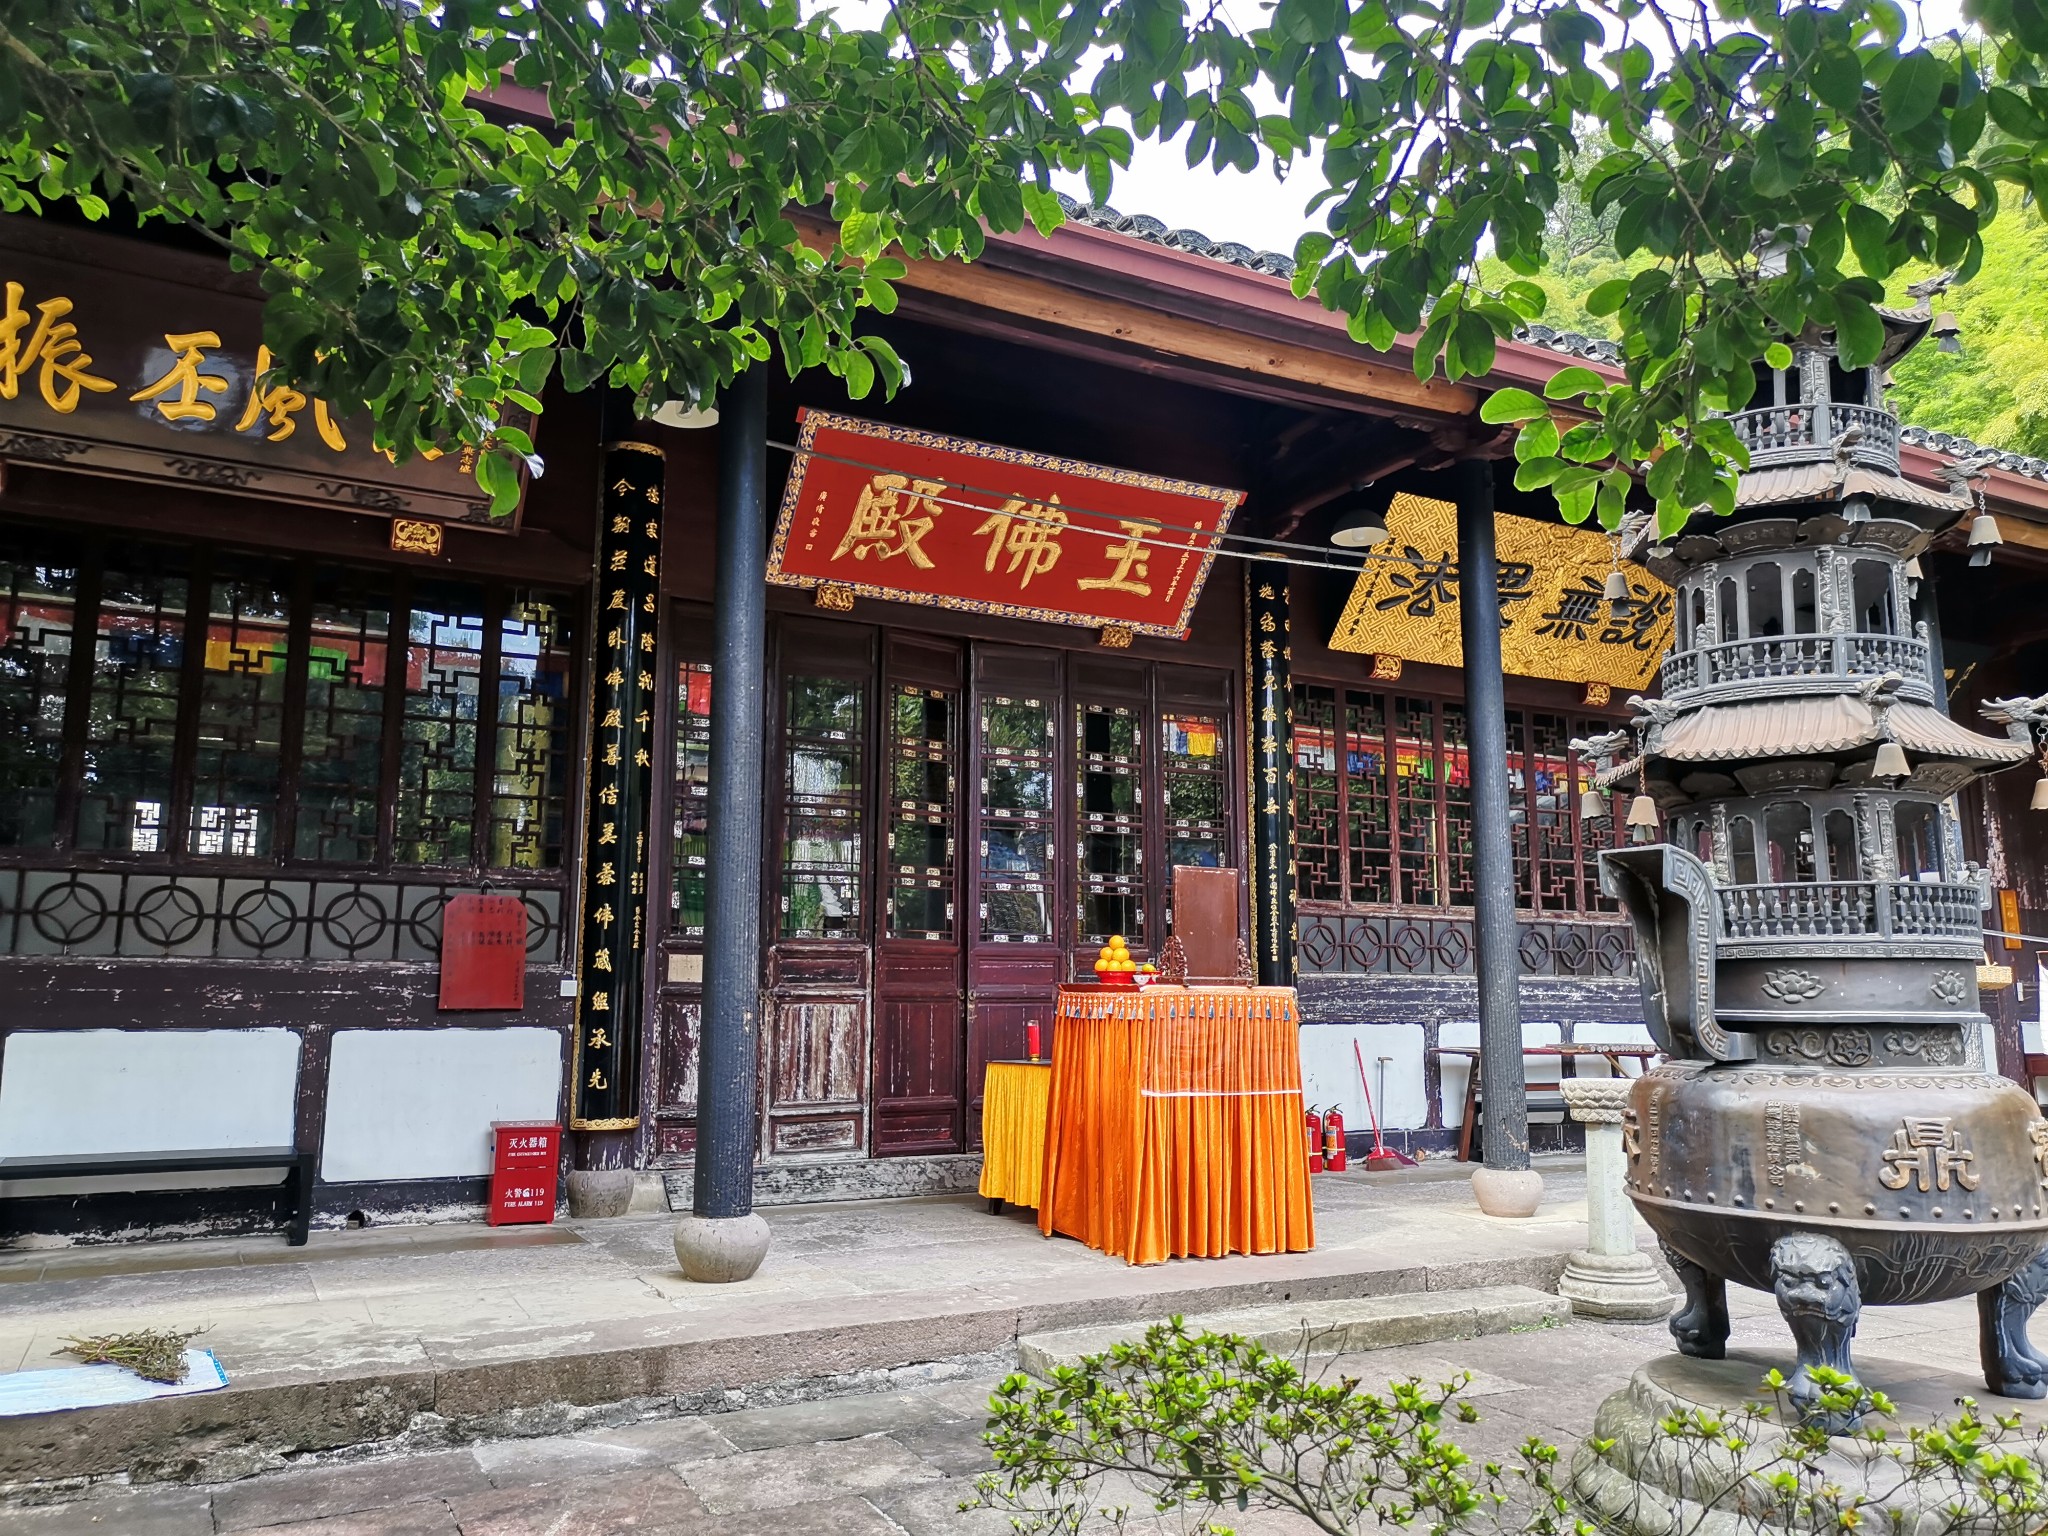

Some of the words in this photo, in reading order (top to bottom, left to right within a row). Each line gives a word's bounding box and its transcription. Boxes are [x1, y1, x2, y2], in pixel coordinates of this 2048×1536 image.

[830, 473, 1163, 597] 玉佛殿
[508, 1137, 548, 1149] 灭火器箱
[1877, 1115, 1981, 1192] 鼎
